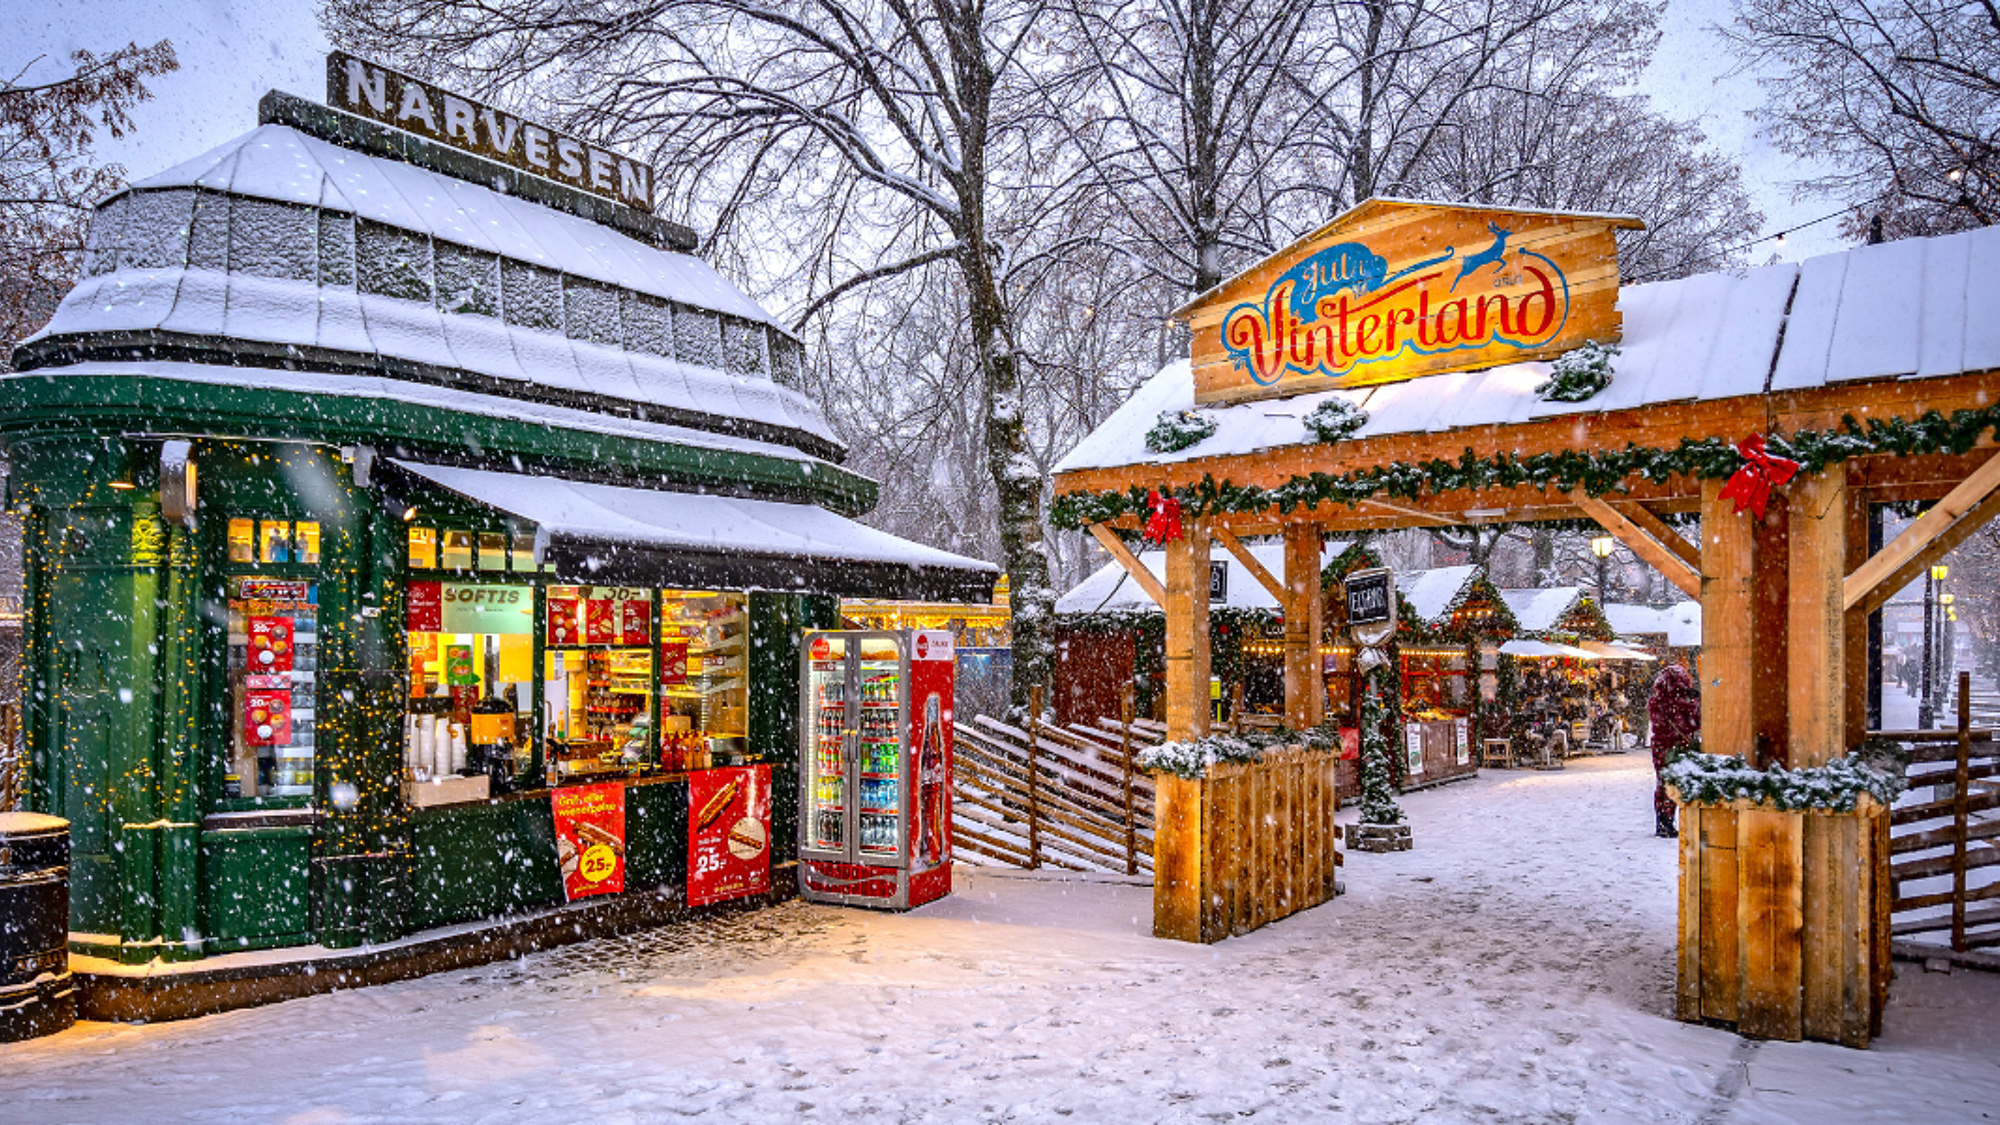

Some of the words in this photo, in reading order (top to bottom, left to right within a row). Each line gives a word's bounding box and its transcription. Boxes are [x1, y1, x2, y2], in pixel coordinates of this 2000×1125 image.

[345, 58, 649, 202] NARVESEN
[1301, 252, 1355, 306] Jul
[1493, 273, 1523, 288] OSLO
[1231, 265, 1556, 378] Vinterland
[444, 587, 521, 605] SOFTIS
